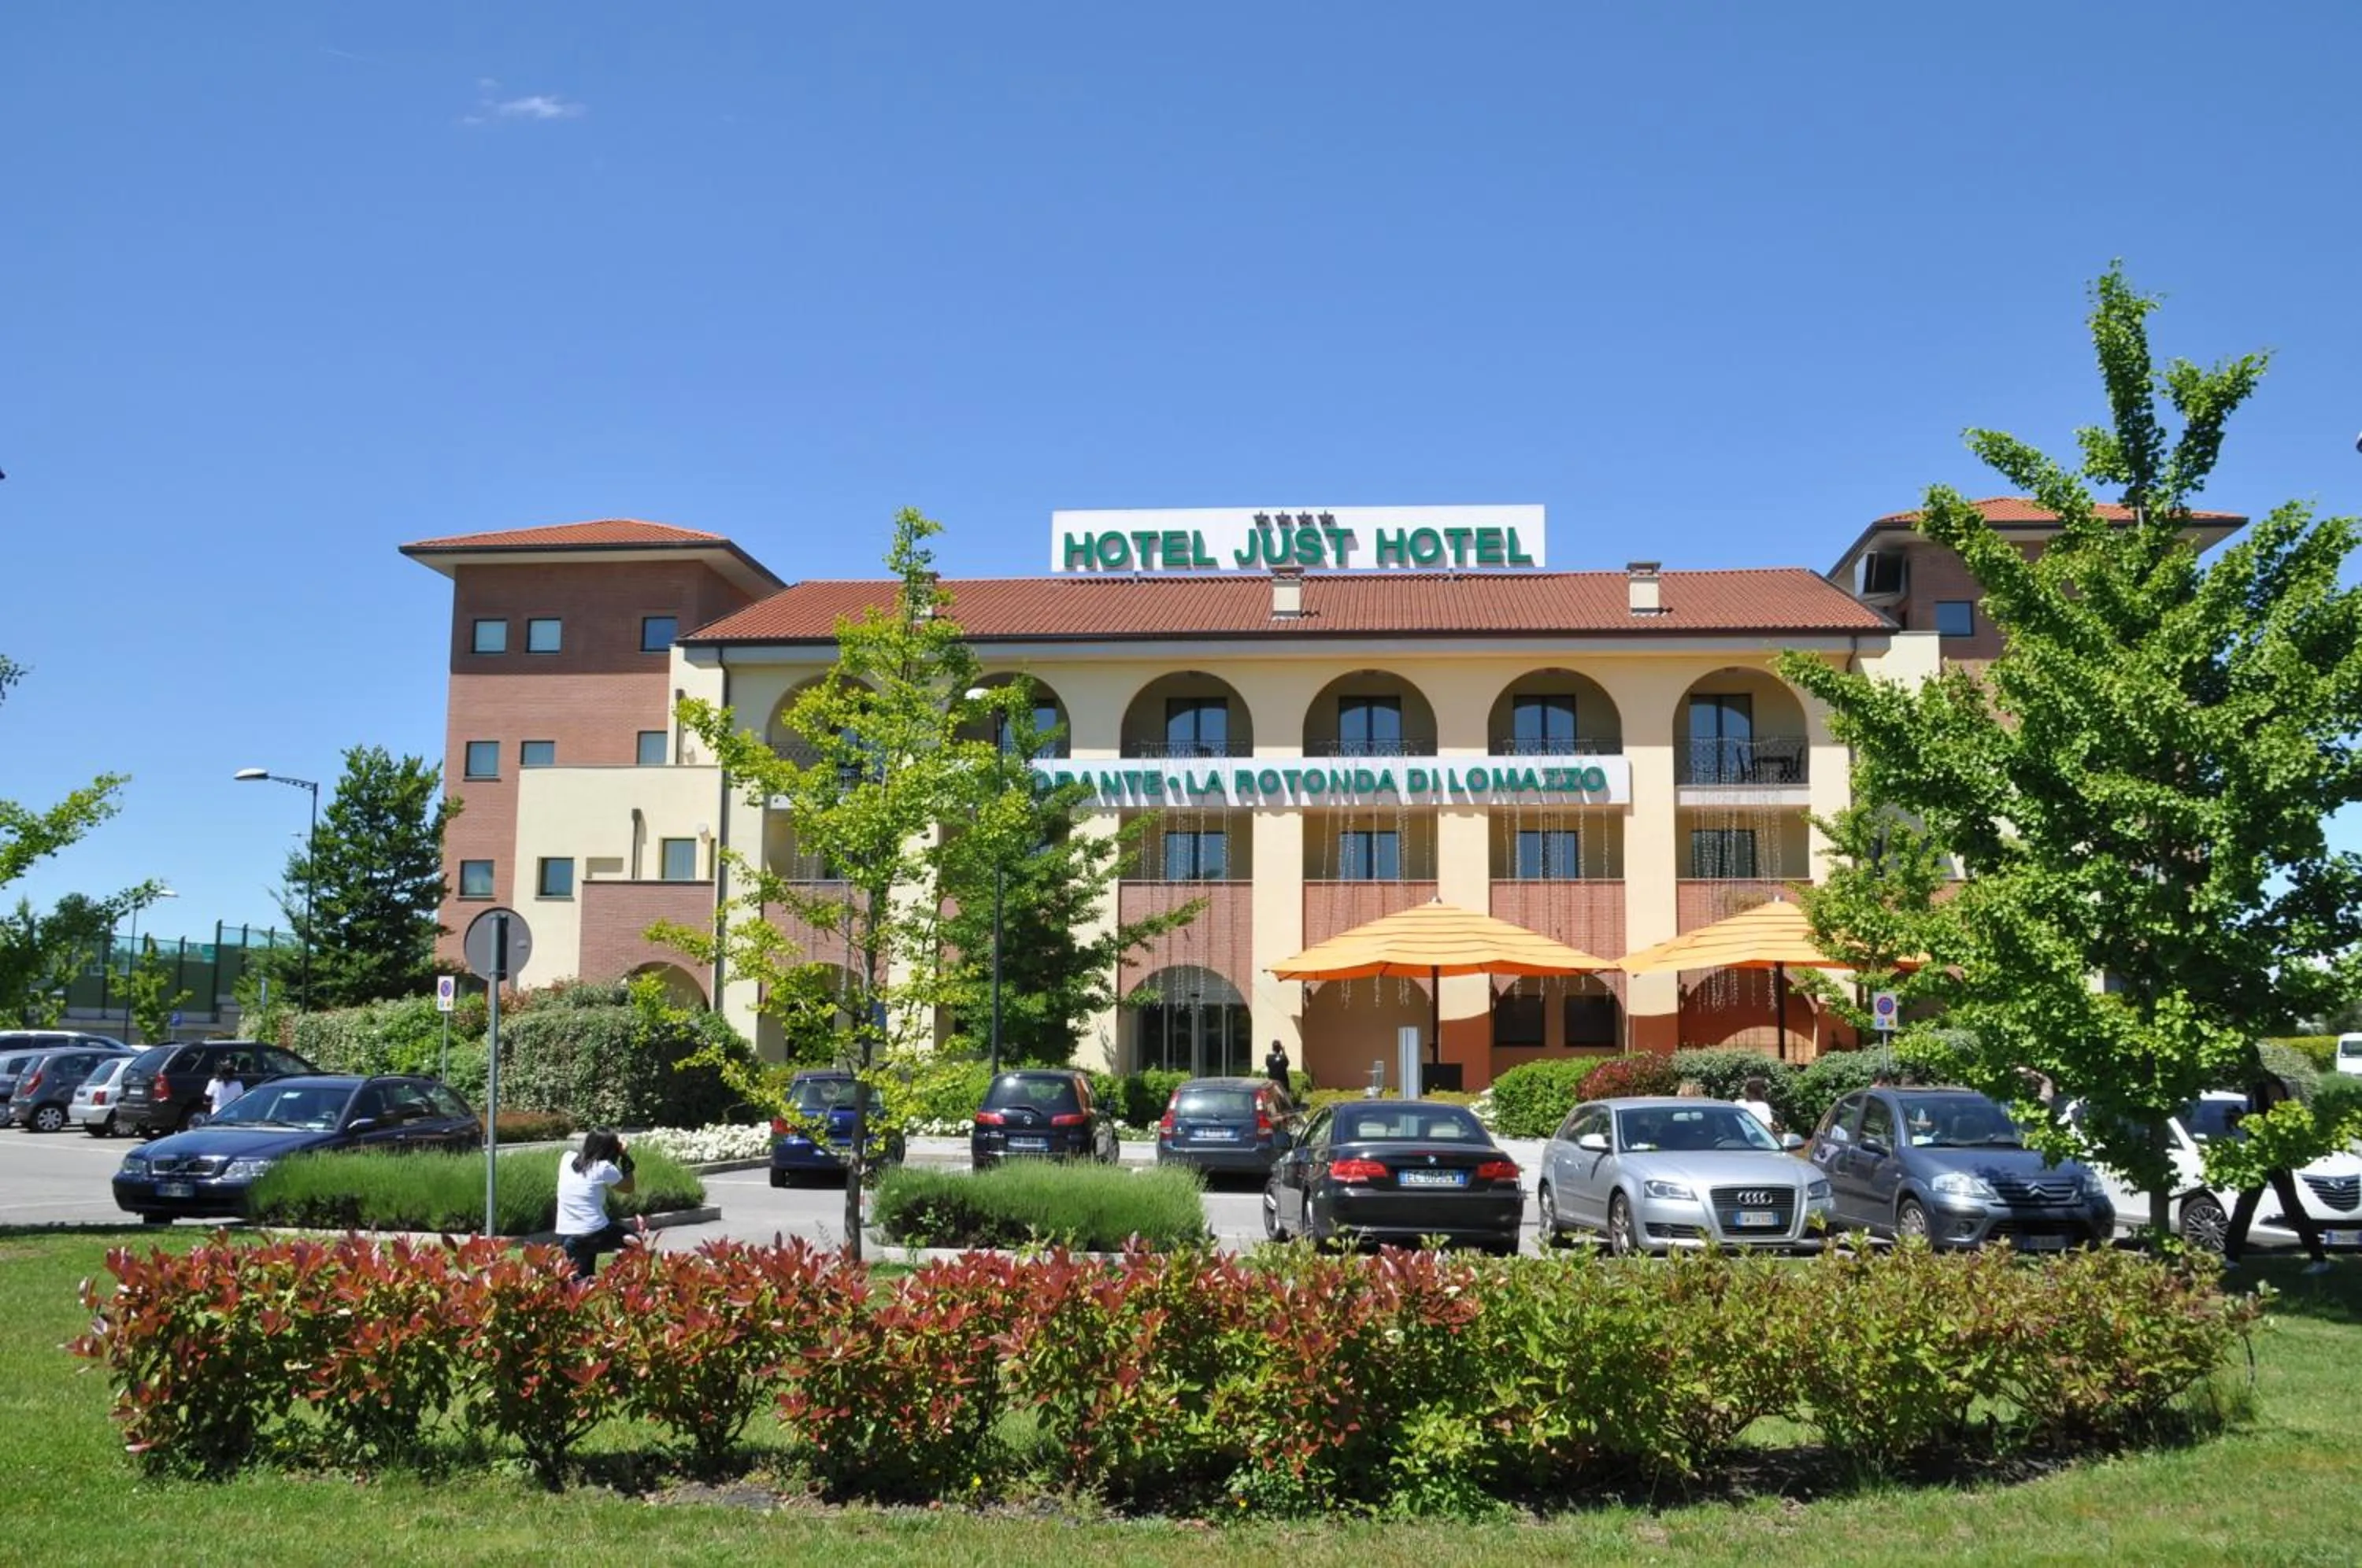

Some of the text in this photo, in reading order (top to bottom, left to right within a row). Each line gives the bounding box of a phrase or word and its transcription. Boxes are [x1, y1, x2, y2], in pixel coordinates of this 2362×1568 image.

[1064, 527, 1534, 568] HOTEL JUST HOTEL
[1186, 769, 1225, 794] LA
[1235, 768, 1399, 795] ROTONDA
[1407, 767, 1438, 793] DI
[1448, 767, 1607, 793] LOMAZZO
